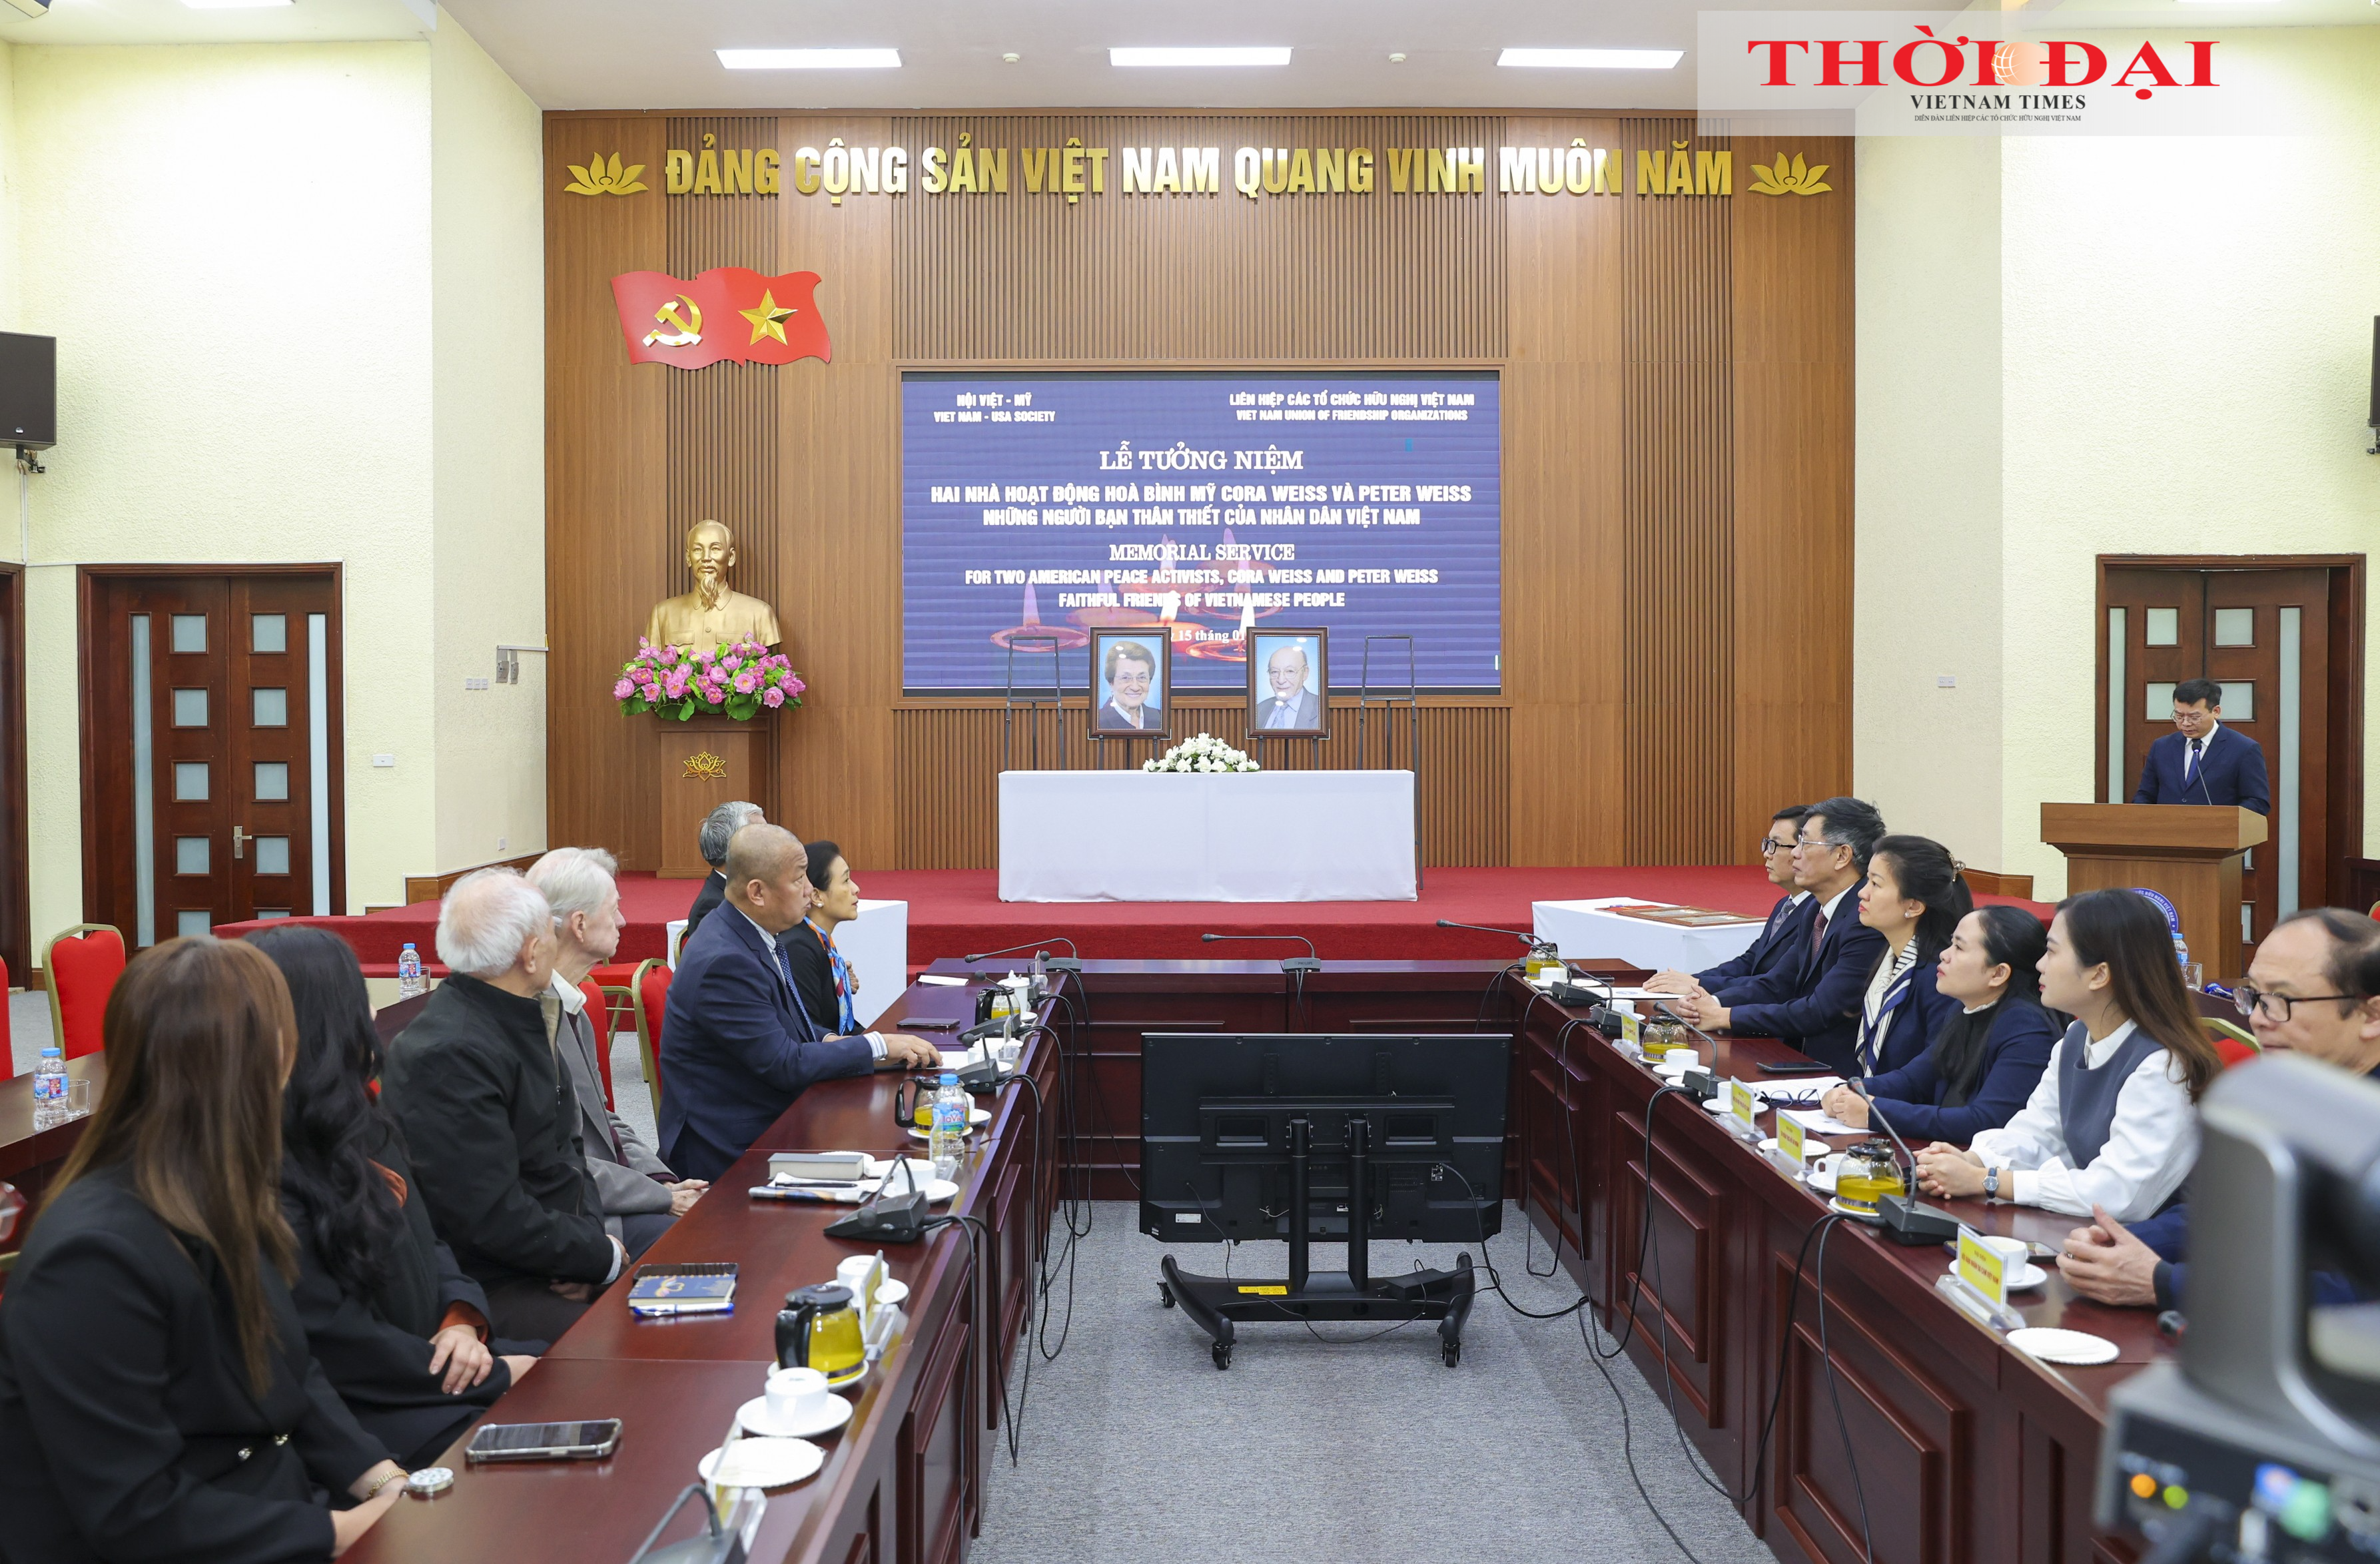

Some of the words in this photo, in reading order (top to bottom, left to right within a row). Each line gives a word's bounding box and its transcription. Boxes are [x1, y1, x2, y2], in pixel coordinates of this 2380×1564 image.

[665, 133, 779, 194] ĐẢNG
[795, 138, 907, 204] CỘNG
[922, 133, 1007, 193] SẢN
[1022, 138, 1108, 202] VIỆT
[1123, 147, 1219, 193] NAM
[1235, 147, 1373, 198] QUANG
[1388, 147, 1485, 194] VINH
[1500, 138, 1623, 195] MUÔN
[1637, 141, 1731, 195] NĂM
[957, 392, 977, 409] HỘI
[979, 392, 1004, 409] VIỆT
[1014, 392, 1032, 406] MỸ
[1229, 391, 1256, 406] LIÊN
[1258, 391, 1285, 408] HIỆP
[1287, 391, 1311, 406] CÁC
[1312, 389, 1328, 406] TỔ
[1330, 390, 1362, 406] CHỨC
[1364, 391, 1388, 406] HỮU
[1390, 393, 1418, 408] NGHỊ
[1420, 391, 1445, 408] VIỆT
[1447, 394, 1475, 406] NAM
[933, 411, 957, 422] VIET
[958, 411, 982, 422] NAM
[991, 411, 1012, 422] USA
[1014, 410, 1056, 422] SOCIETY
[1236, 410, 1258, 420] VIET
[1259, 410, 1283, 420] NAM
[1284, 410, 1316, 421] UNION
[1317, 410, 1330, 420] OF
[1332, 410, 1389, 420] FRIENDSHIP
[1391, 410, 1468, 421] ORGANIZATIONS
[1099, 440, 1132, 470] LỄ
[1138, 441, 1228, 470] TƯỞNG
[1234, 444, 1304, 474] NIỆM
[931, 486, 960, 502] HAI
[965, 483, 1000, 502] NHÀ
[1004, 486, 1049, 506] HOẠT
[1052, 482, 1100, 506] ĐỘNG
[1104, 482, 1140, 502] HOÀ
[1144, 482, 1185, 502] BÌNH
[1190, 482, 1216, 502] MỸ
[1221, 485, 1267, 502] CORA
[1271, 485, 1328, 502] WEISS
[1332, 482, 1355, 502] VÀ
[1358, 485, 1411, 502] PETER
[1415, 485, 1471, 502] WEISS
[983, 506, 1038, 526] NHỮNG
[1042, 506, 1091, 526] NGƯỜI
[1095, 509, 1128, 529] BẠN
[1132, 506, 1174, 525] THÂN
[1177, 504, 1220, 525] THIẾT
[1224, 504, 1257, 526] CỦA
[1260, 506, 1305, 525] NHÂN
[1310, 506, 1342, 525] DÂN
[1346, 506, 1380, 528] VIỆT
[1383, 508, 1420, 525] NAM
[1109, 544, 1211, 562] MEMORIAL
[1215, 544, 1295, 561] SERVICE
[965, 570, 991, 584] FOR
[994, 570, 1026, 584] TWO
[1028, 570, 1101, 584] AMERICAN
[1104, 570, 1148, 584] PEACE
[1151, 569, 1224, 586] ACTIVISTS,
[1228, 569, 1265, 584] CORA
[1268, 569, 1313, 584] WEISS
[1316, 569, 1345, 584] AND
[1348, 569, 1390, 584] PETER
[1393, 569, 1438, 584] WEISS
[1058, 593, 1120, 607] FAITHFUL
[1184, 593, 1202, 607] OF
[1204, 593, 1290, 607] VIETNAMESE
[1294, 592, 1345, 607] PEOPLE
[1178, 629, 1192, 641] 15
[1195, 629, 1230, 644] tháng
[1232, 629, 1246, 641] 01
